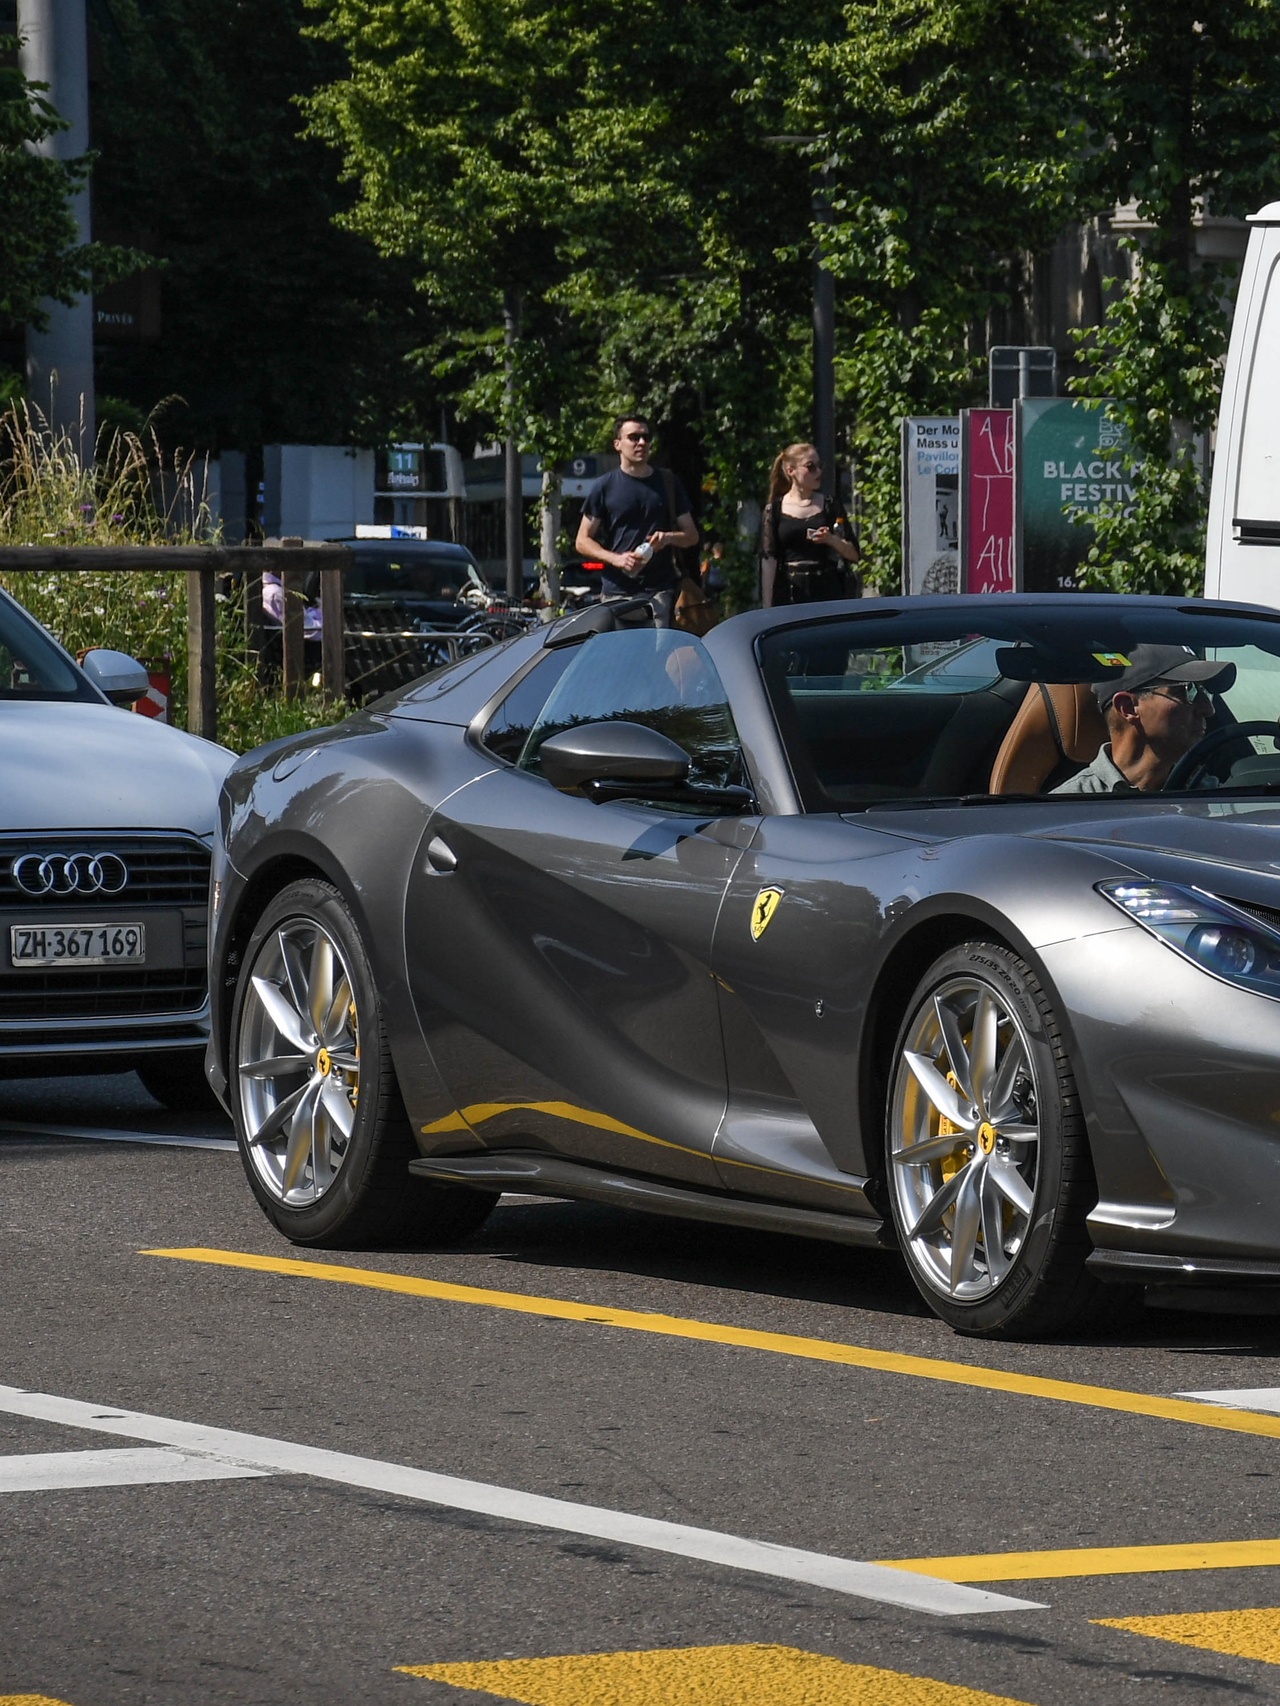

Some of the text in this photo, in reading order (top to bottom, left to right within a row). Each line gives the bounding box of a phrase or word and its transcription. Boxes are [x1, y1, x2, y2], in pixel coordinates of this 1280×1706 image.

[917, 425, 938, 435] Der
[917, 438, 948, 448] Mass
[395, 453, 413, 469] 11
[573, 459, 586, 476] 9
[918, 465, 931, 475] Le
[1043, 461, 1122, 479] BLACK
[1061, 483, 1140, 502] FESTIV
